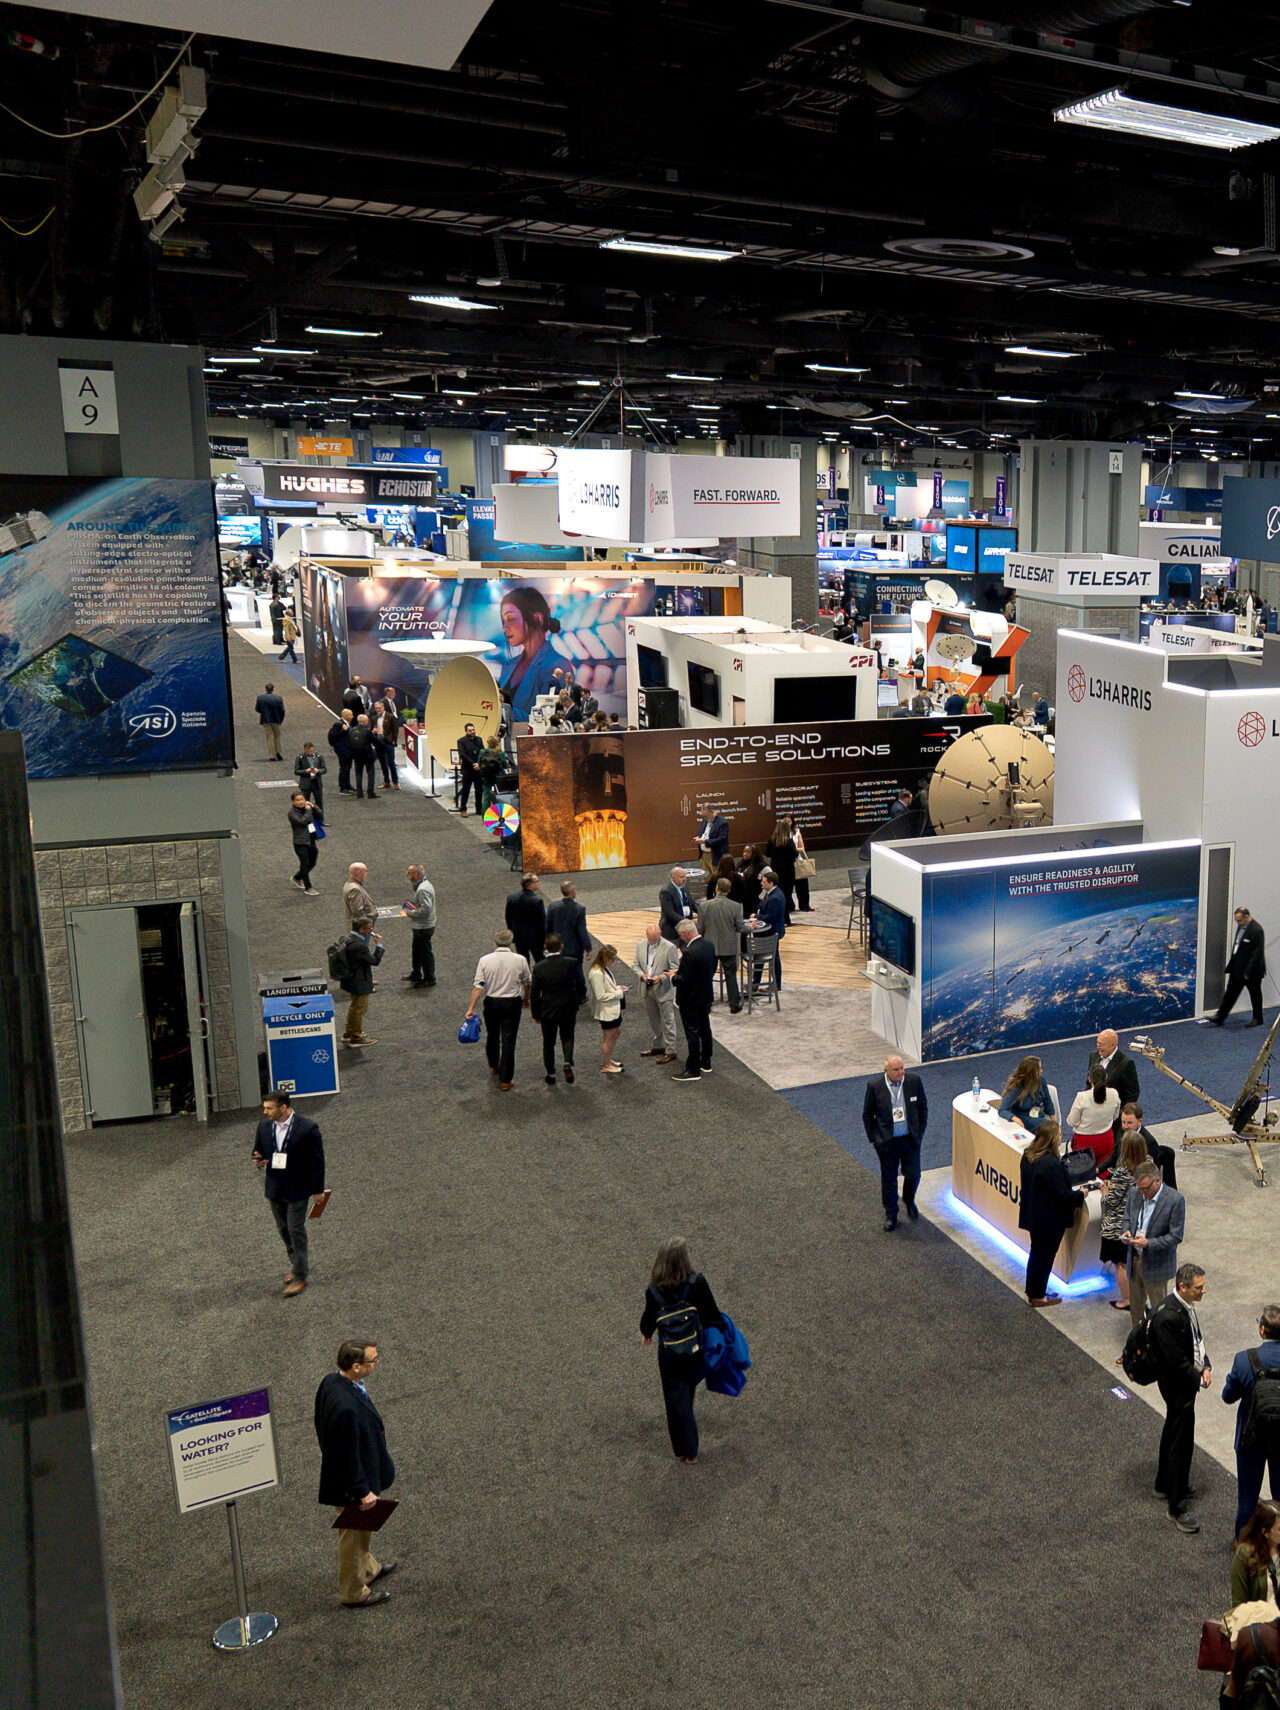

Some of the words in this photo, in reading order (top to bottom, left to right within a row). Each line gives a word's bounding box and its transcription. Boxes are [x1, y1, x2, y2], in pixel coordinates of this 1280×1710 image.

[78, 376, 99, 398] A
[82, 404, 98, 426] 9
[1112, 454, 1120, 462] A
[280, 475, 365, 494] HUGHES
[378, 479, 432, 497] ECHOSTAR
[693, 489, 723, 501] FAST.
[725, 489, 780, 501] FORWARD.
[67, 522, 122, 532] AROUND
[128, 522, 152, 532] THE
[1168, 544, 1219, 557] CALIAN
[1008, 563, 1054, 583] TELESAT
[1067, 571, 1151, 586] TELESAT
[876, 585, 923, 593] CONNECTING
[379, 612, 423, 621] YOUR
[379, 621, 451, 630] INTUITION
[1161, 632, 1195, 647] TELESAT
[1090, 678, 1152, 711] L3HARRIS
[680, 732, 821, 751] END-TO-END
[680, 750, 757, 767] SPACE
[765, 744, 891, 762] SOLUTIONS
[1009, 873, 1043, 884] ENSURE
[1046, 868, 1093, 880] READINESS
[1094, 867, 1101, 875] &
[1103, 863, 1136, 875] AGILITY
[1009, 886, 1033, 896] WITH
[1035, 883, 1051, 893] THE
[1053, 880, 1091, 891] TRUSTED
[1092, 874, 1139, 887] DISRUPTOR
[267, 987, 301, 996] LANDFILL
[270, 1014, 303, 1023] RECYCLE
[975, 1158, 1021, 1206] AIRBU
[180, 1429, 236, 1451] LOOKING
[238, 1422, 262, 1435] FOR
[181, 1443, 230, 1462] WATER?
